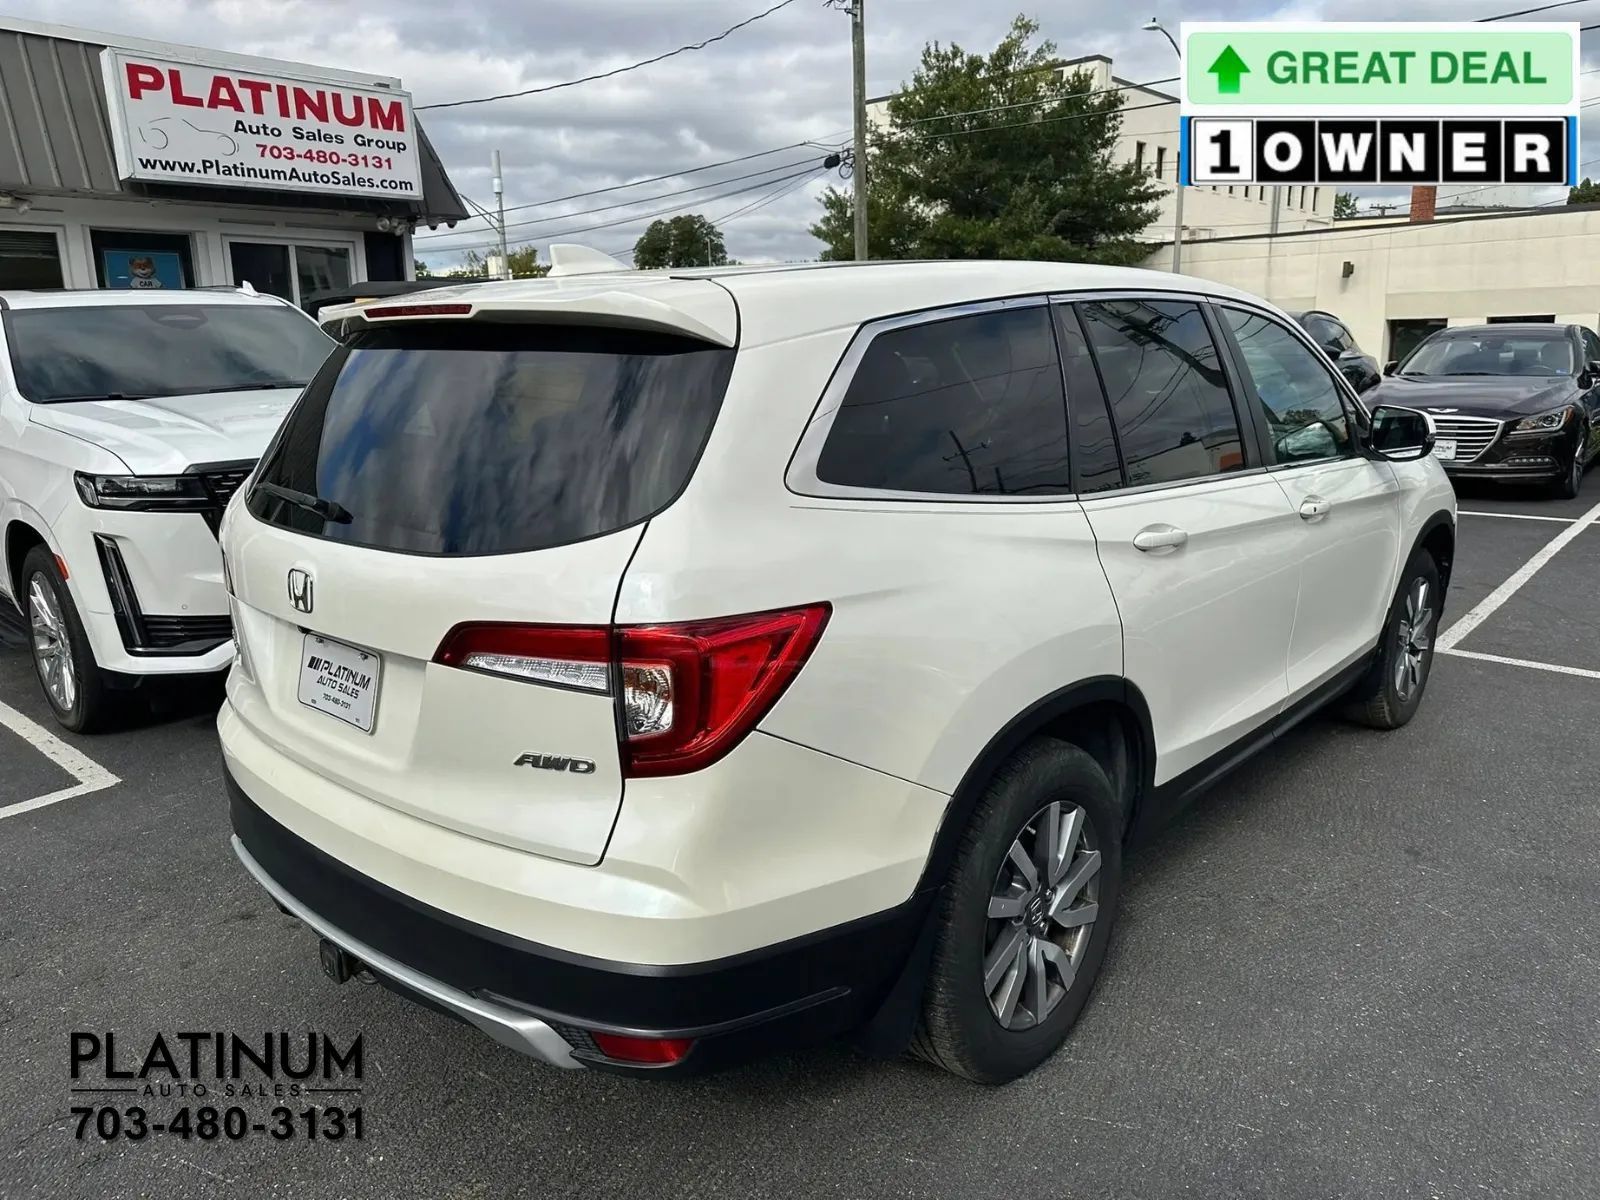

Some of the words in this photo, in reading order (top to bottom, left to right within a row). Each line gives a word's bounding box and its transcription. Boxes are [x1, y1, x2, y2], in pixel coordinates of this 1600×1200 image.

[125, 62, 405, 133] PLATINUM
[234, 119, 282, 138] Auto
[292, 126, 344, 145] Sales
[353, 134, 407, 153] Group
[255, 143, 393, 170] 703-480-3131
[138, 157, 413, 191] www.PlatinumAutoSales.com
[317, 675, 338, 690] AUTO
[337, 682, 360, 699] SALES
[320, 659, 371, 691] PLATINUM
[513, 752, 596, 774] AWD
